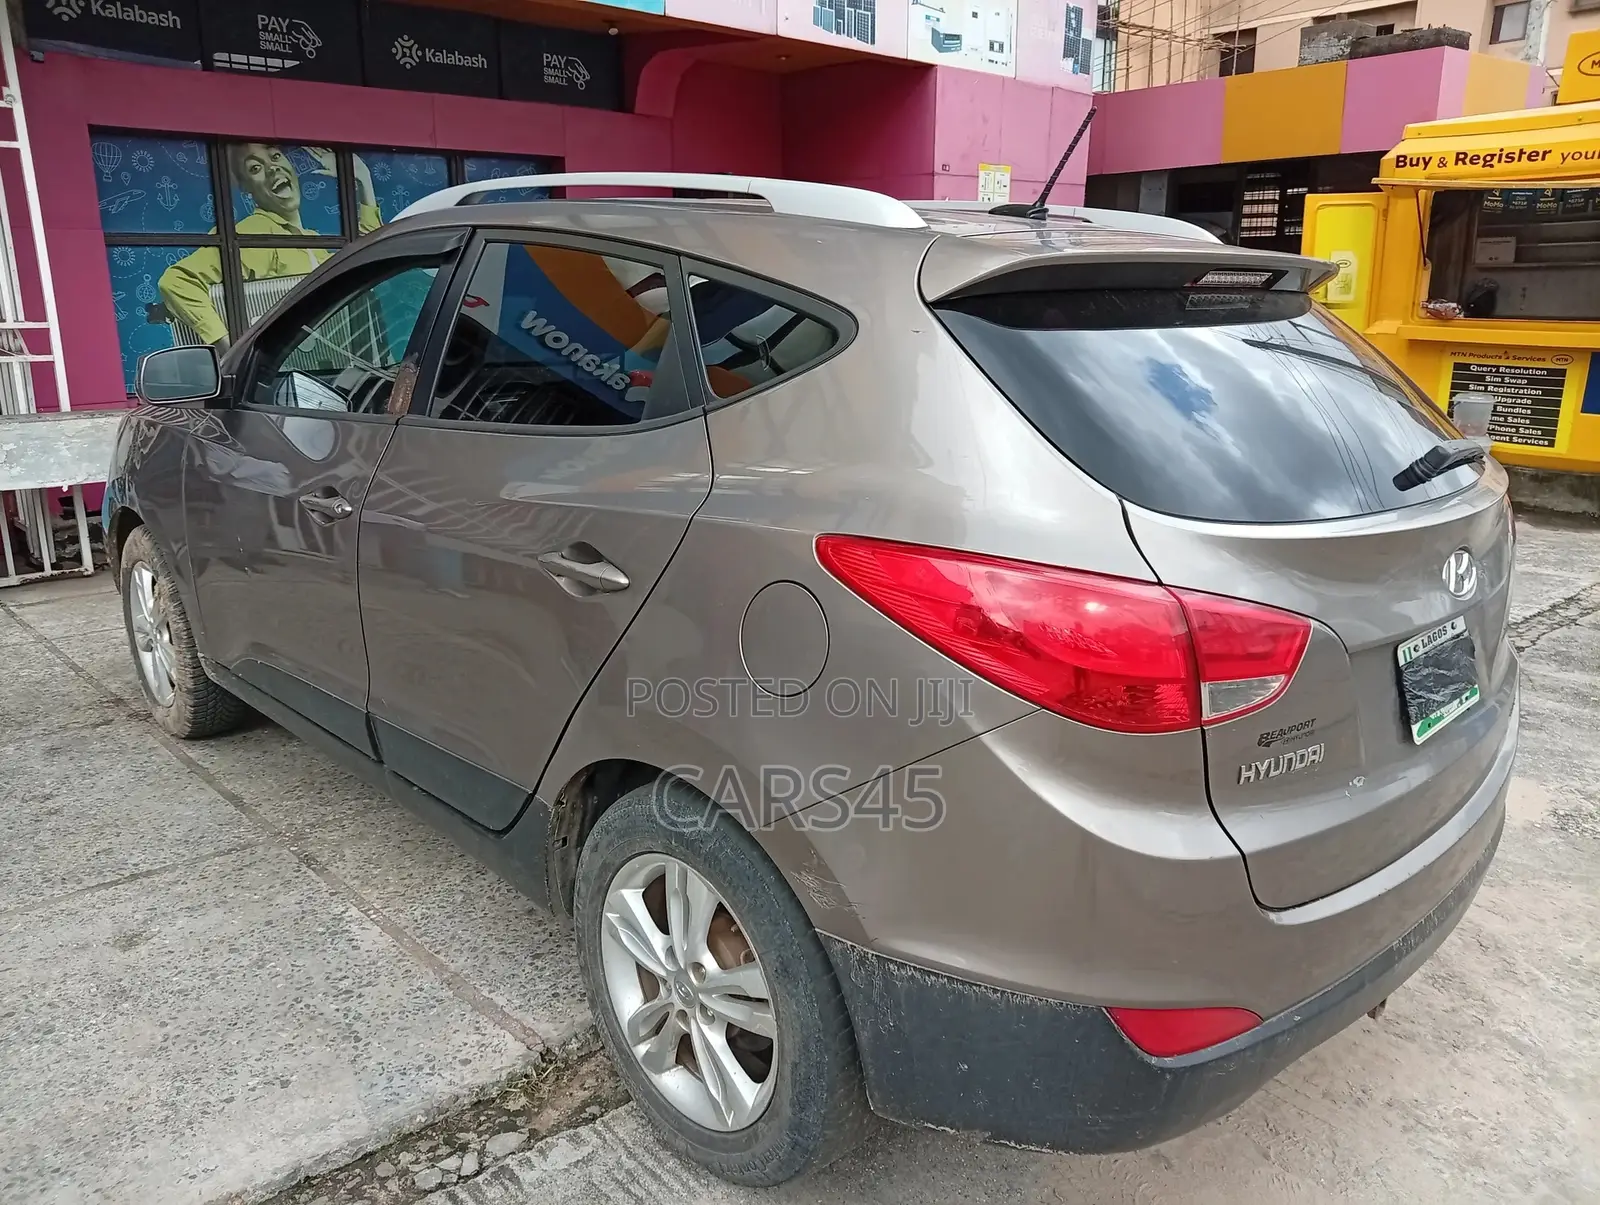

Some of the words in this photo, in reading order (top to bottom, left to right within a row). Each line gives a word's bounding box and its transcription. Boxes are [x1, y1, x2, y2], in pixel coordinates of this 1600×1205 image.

[90, 0, 182, 30] Kalabash
[257, 14, 290, 33] PAY
[259, 31, 292, 44] SMALL
[260, 41, 293, 53] SMALL
[425, 48, 488, 69] Kalabash
[543, 53, 567, 69] PAY
[543, 67, 568, 78] SMALL
[544, 75, 569, 86] SMALL
[1395, 154, 1433, 171] Buy
[1437, 156, 1448, 168] &
[1454, 148, 1552, 169] Register
[1483, 200, 1504, 209] MoMo
[1536, 202, 1558, 210] MoMo
[1468, 352, 1502, 360] Products
[1511, 354, 1546, 362] Services
[1470, 365, 1497, 373] Query
[1499, 366, 1547, 376] Resolution
[1504, 377, 1528, 385] Swap
[1487, 385, 1542, 395] Registration
[1494, 395, 1532, 405] Upgrade
[1496, 406, 1532, 414] Bundles
[1507, 416, 1530, 424] Sales
[1489, 424, 1516, 433] Phone
[1519, 427, 1542, 435] Sales
[1512, 436, 1549, 446] Services
[1420, 625, 1448, 649] LAGOS
[1257, 718, 1317, 748] BEAUPORT
[1237, 743, 1325, 785] HYUNDAI
